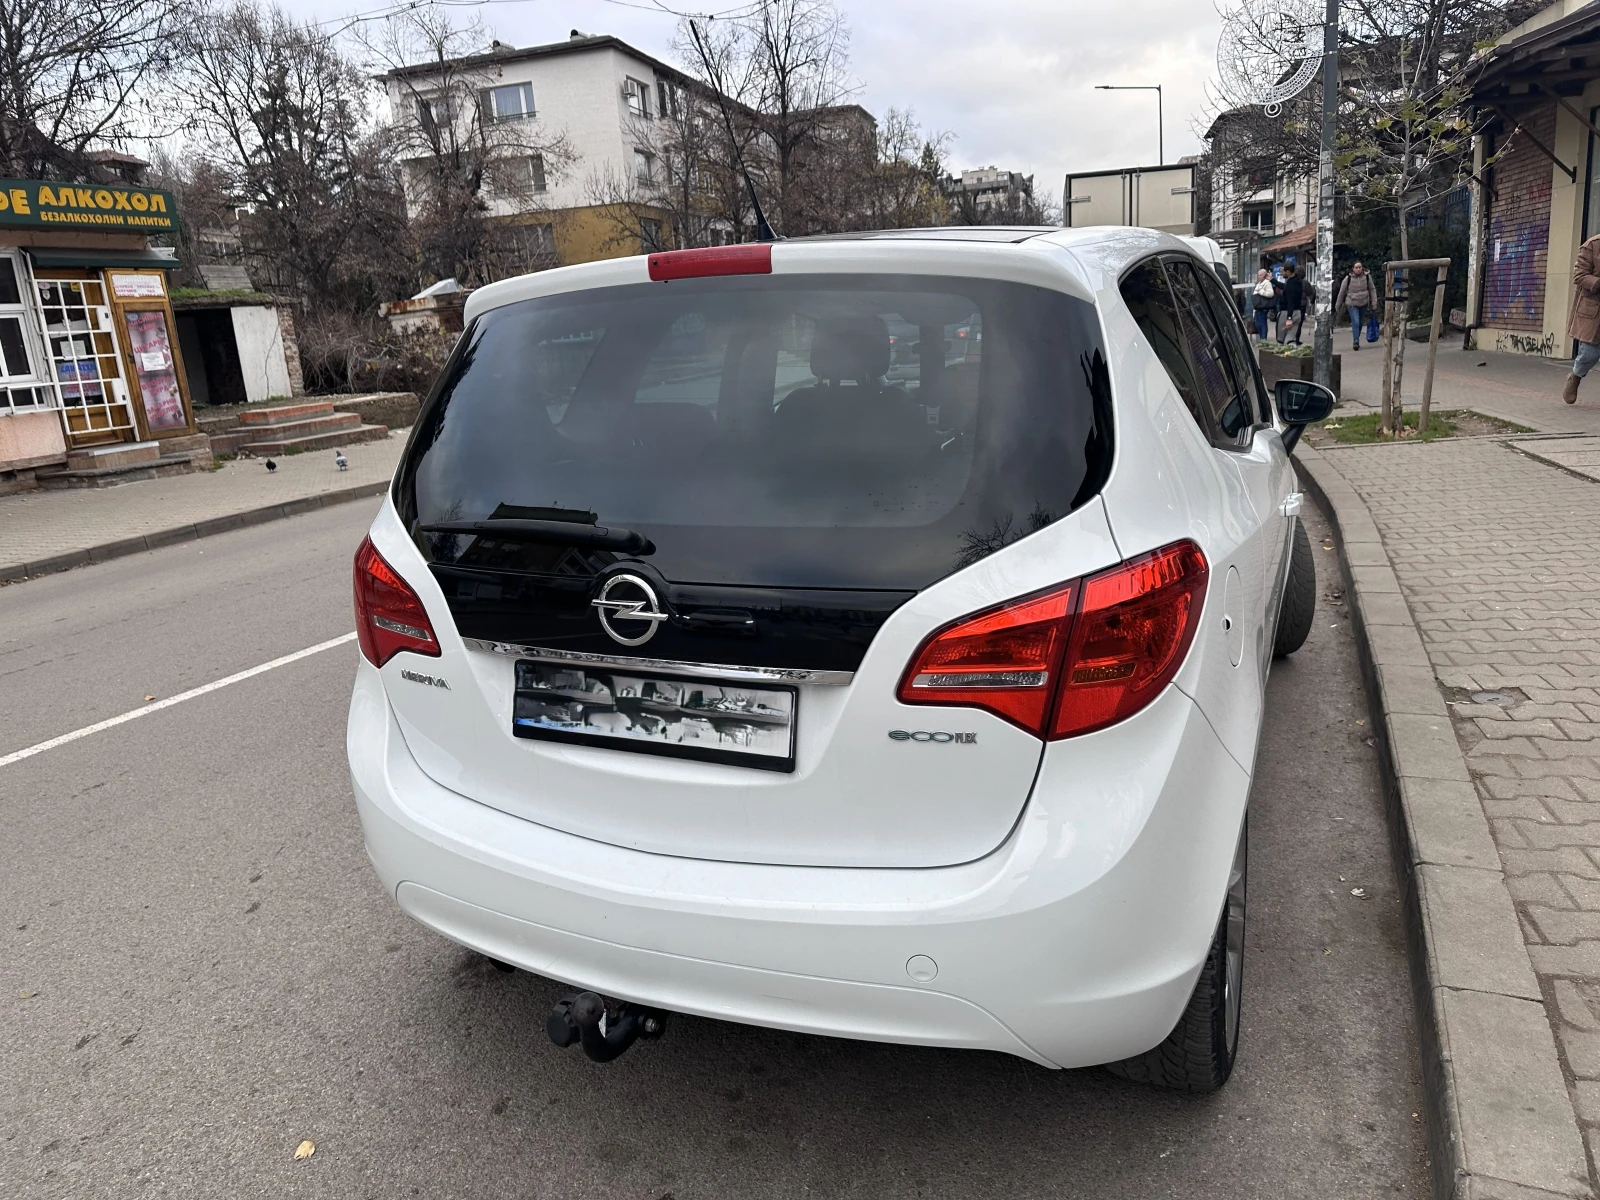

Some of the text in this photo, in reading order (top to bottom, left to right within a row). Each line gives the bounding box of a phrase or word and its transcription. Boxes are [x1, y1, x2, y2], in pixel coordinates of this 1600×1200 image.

[38, 185, 167, 213] АЛКОХОЛ
[40, 211, 172, 227] БЕЗАЛКОХОЛНИ НАПИТКИ
[133, 339, 164, 354] ЦИГАРИ
[401, 669, 452, 691] MERIVA
